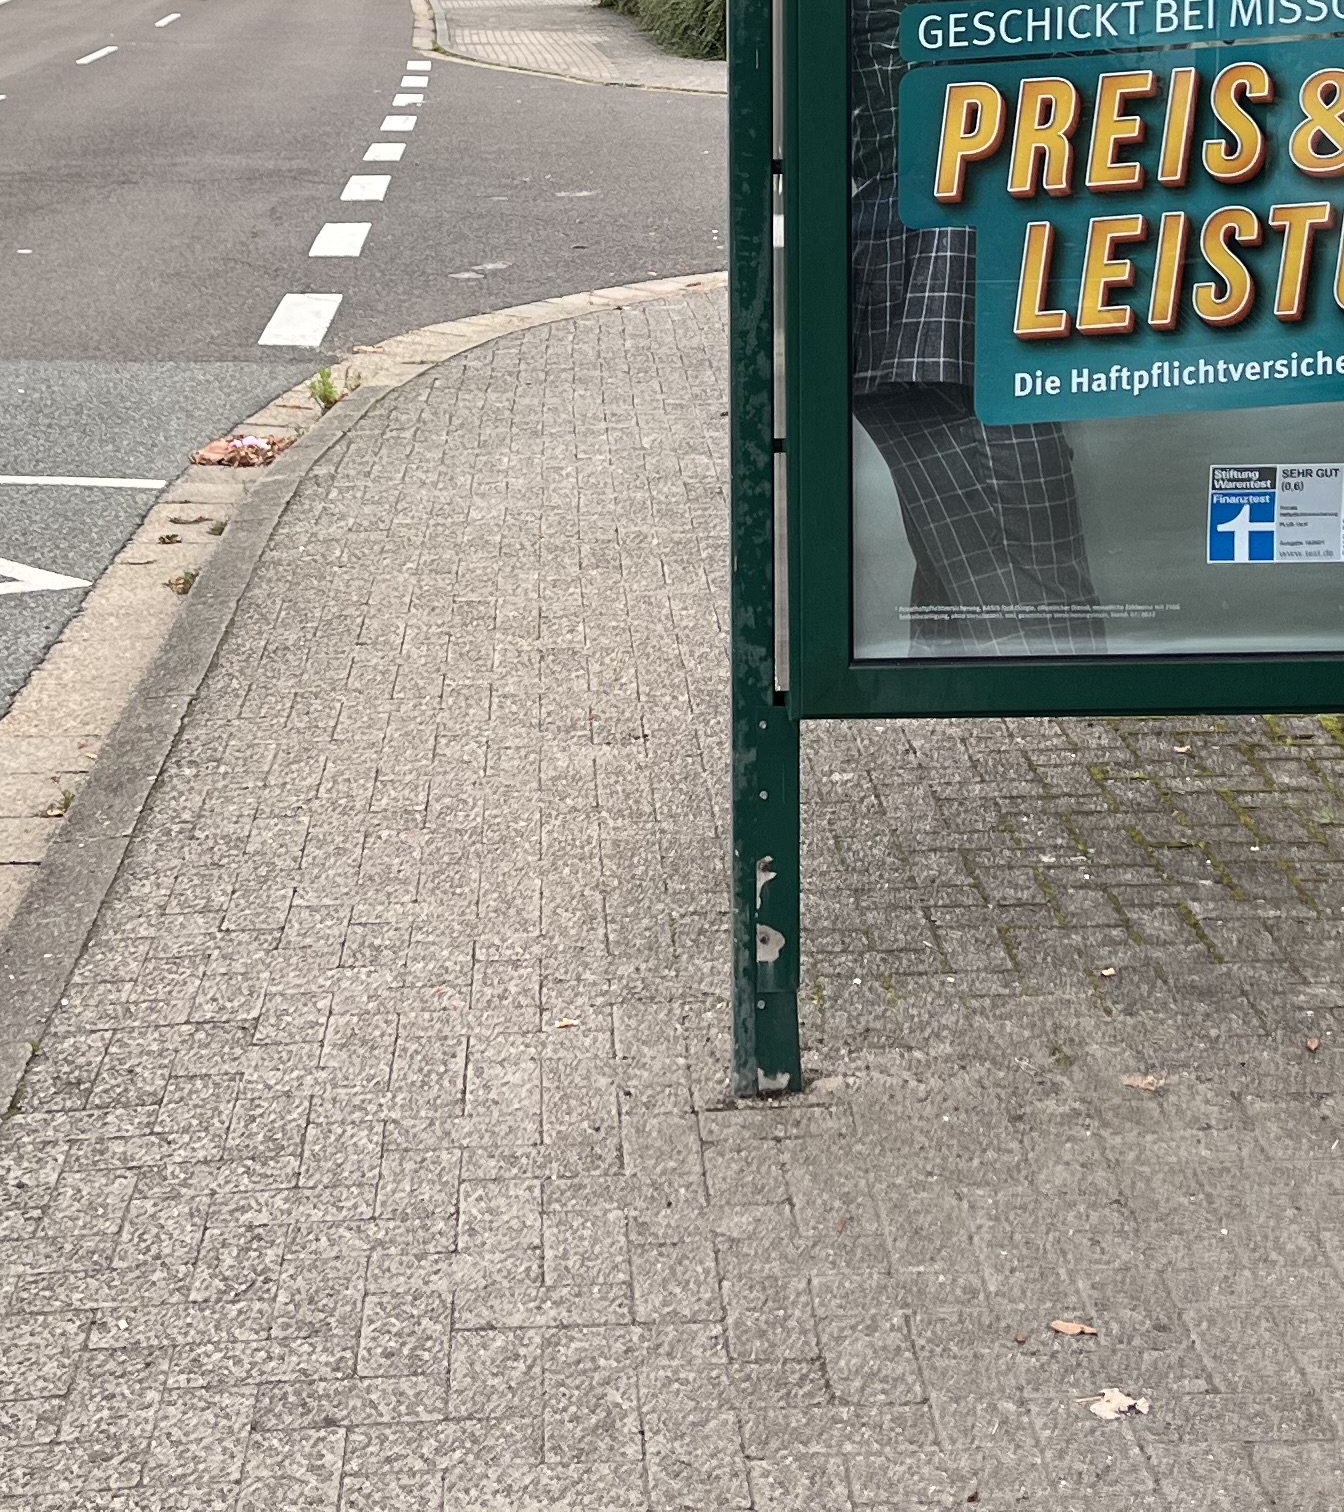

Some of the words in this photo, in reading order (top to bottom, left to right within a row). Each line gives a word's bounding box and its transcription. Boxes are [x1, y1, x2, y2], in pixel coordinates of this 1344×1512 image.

[918, 0, 1144, 49] GESCHICKT
[933, 61, 1273, 202] PREIS
[1014, 370, 1061, 397] Die
[1214, 469, 1259, 480] Stiftung
[1282, 469, 1313, 478] SEHR
[1316, 468, 1340, 478] GUT
[1214, 479, 1272, 489] Warentest
[1281, 482, 1304, 493] (0,6)
[1213, 494, 1270, 504] Finanztest
